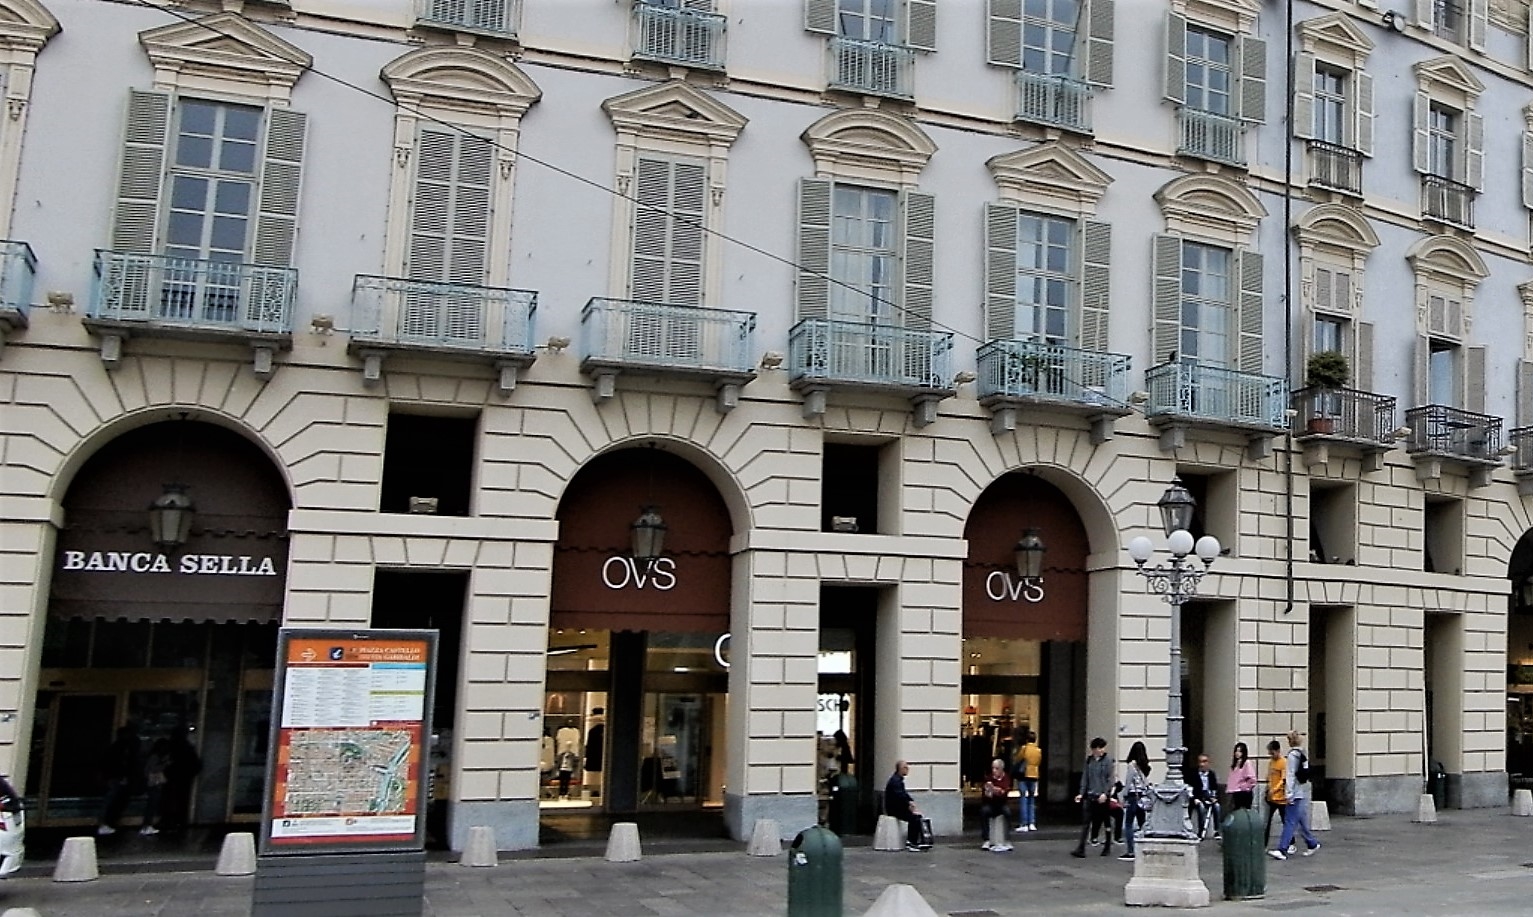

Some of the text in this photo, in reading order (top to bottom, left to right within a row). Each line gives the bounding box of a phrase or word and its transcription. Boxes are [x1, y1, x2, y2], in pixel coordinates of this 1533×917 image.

[63, 551, 277, 576] BANCA SELLA
[602, 556, 677, 591] OVS
[986, 571, 1044, 603] OVS
